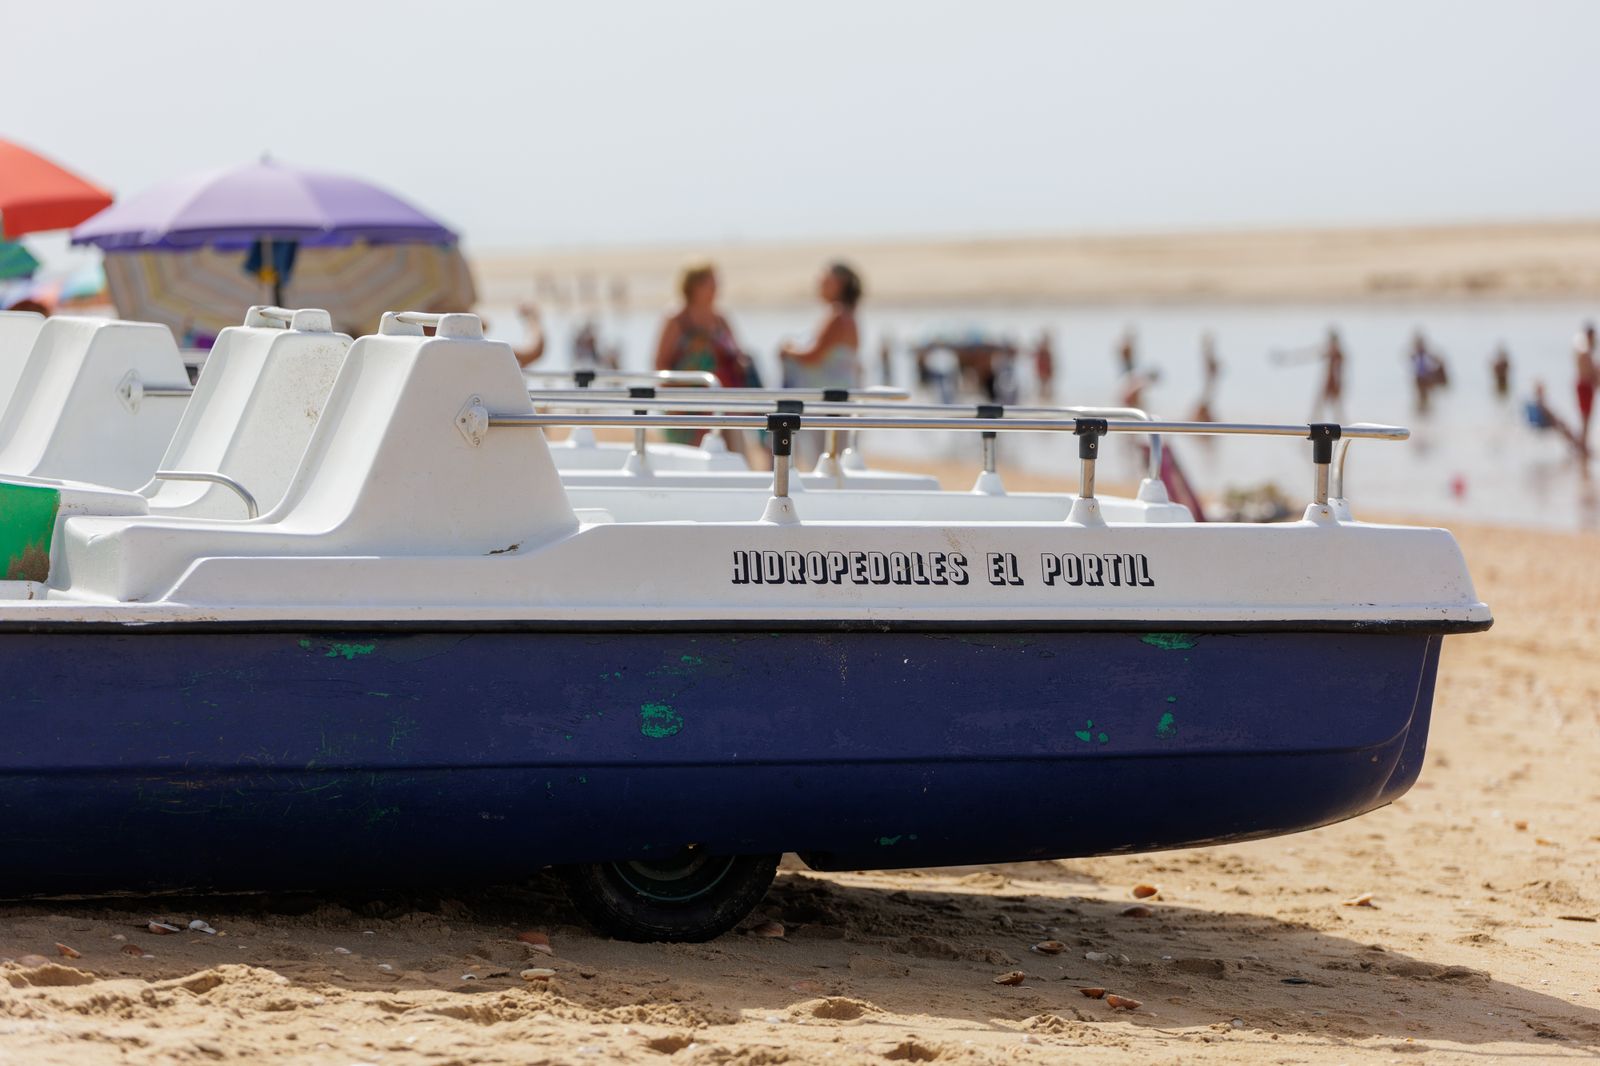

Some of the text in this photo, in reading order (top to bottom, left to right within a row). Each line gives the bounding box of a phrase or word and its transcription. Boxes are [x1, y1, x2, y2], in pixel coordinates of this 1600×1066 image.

[732, 551, 1154, 586] HIDROPEDALES EL PORTIL
